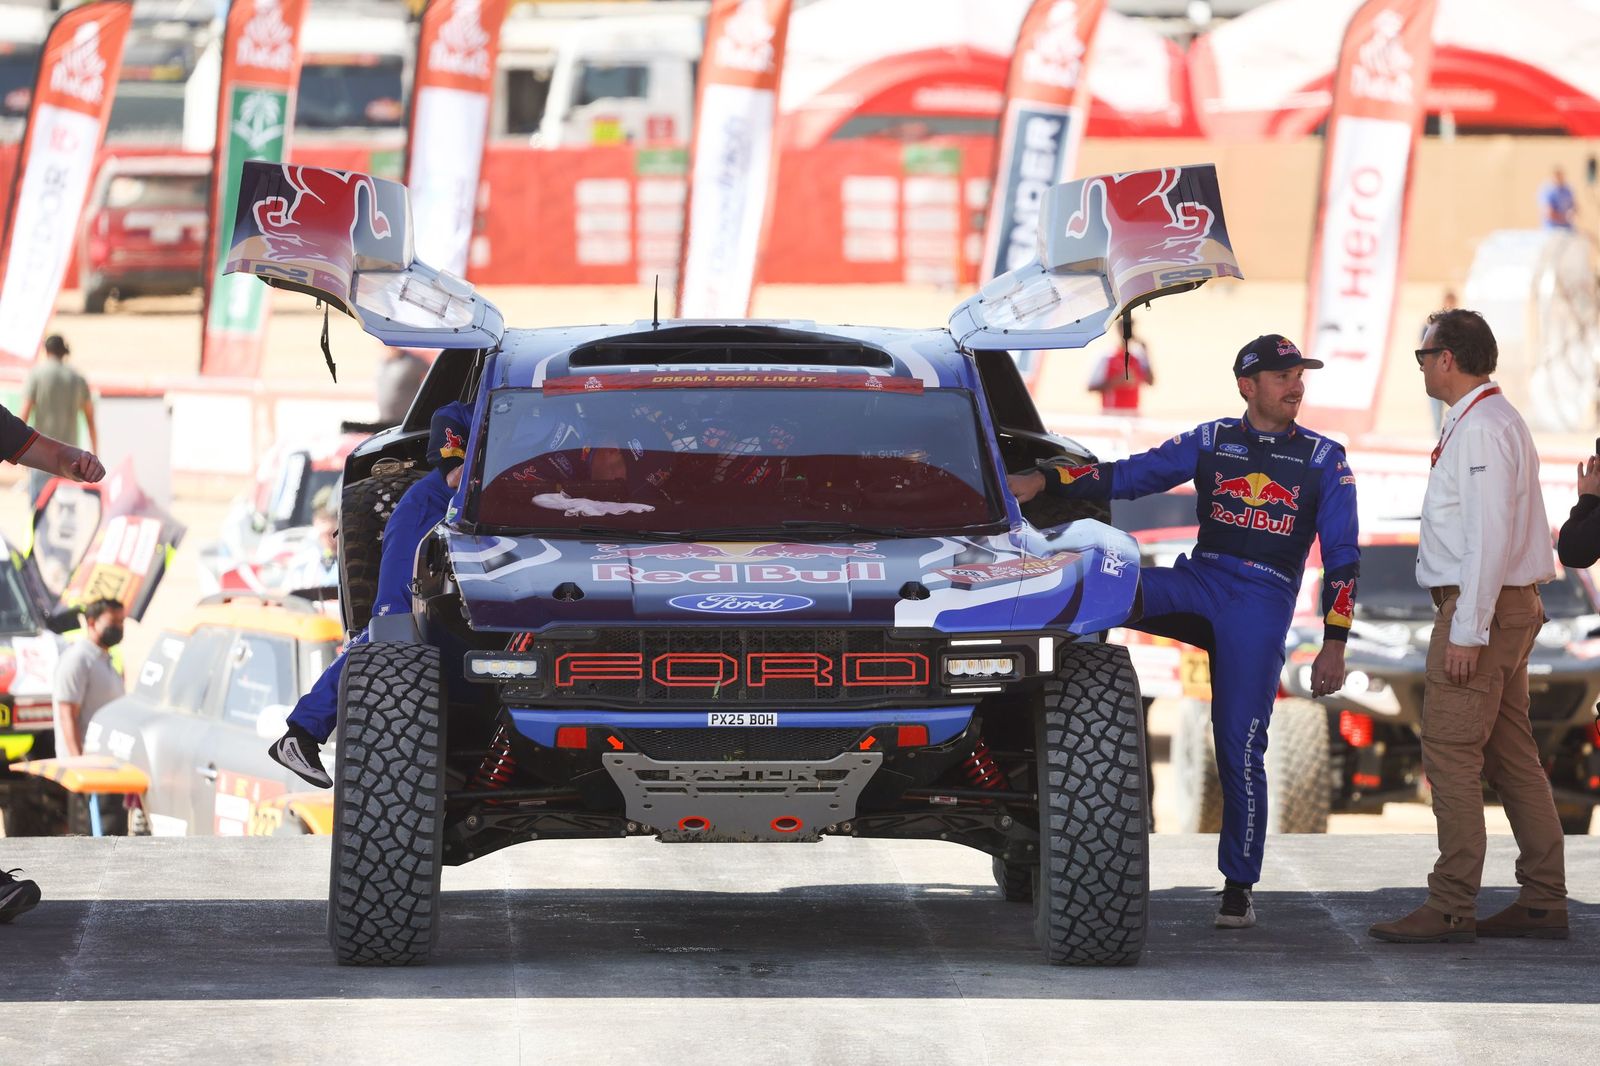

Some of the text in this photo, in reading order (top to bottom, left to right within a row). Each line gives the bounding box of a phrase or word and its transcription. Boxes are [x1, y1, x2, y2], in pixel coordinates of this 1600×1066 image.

[1340, 165, 1384, 299] Hero
[652, 375, 711, 383] DREAM.
[1216, 452, 1249, 461] RACING
[1271, 453, 1304, 464] RAPTOR
[1210, 502, 1296, 536] Red Bull
[592, 562, 886, 583] Red Bull
[1253, 563, 1291, 583] GUTHRIE
[697, 595, 783, 611] Ford
[555, 653, 930, 687] FORD
[711, 714, 774, 725] PX25 BOH
[669, 769, 817, 781] RAPTOR
[1243, 798, 1256, 857] FORD
